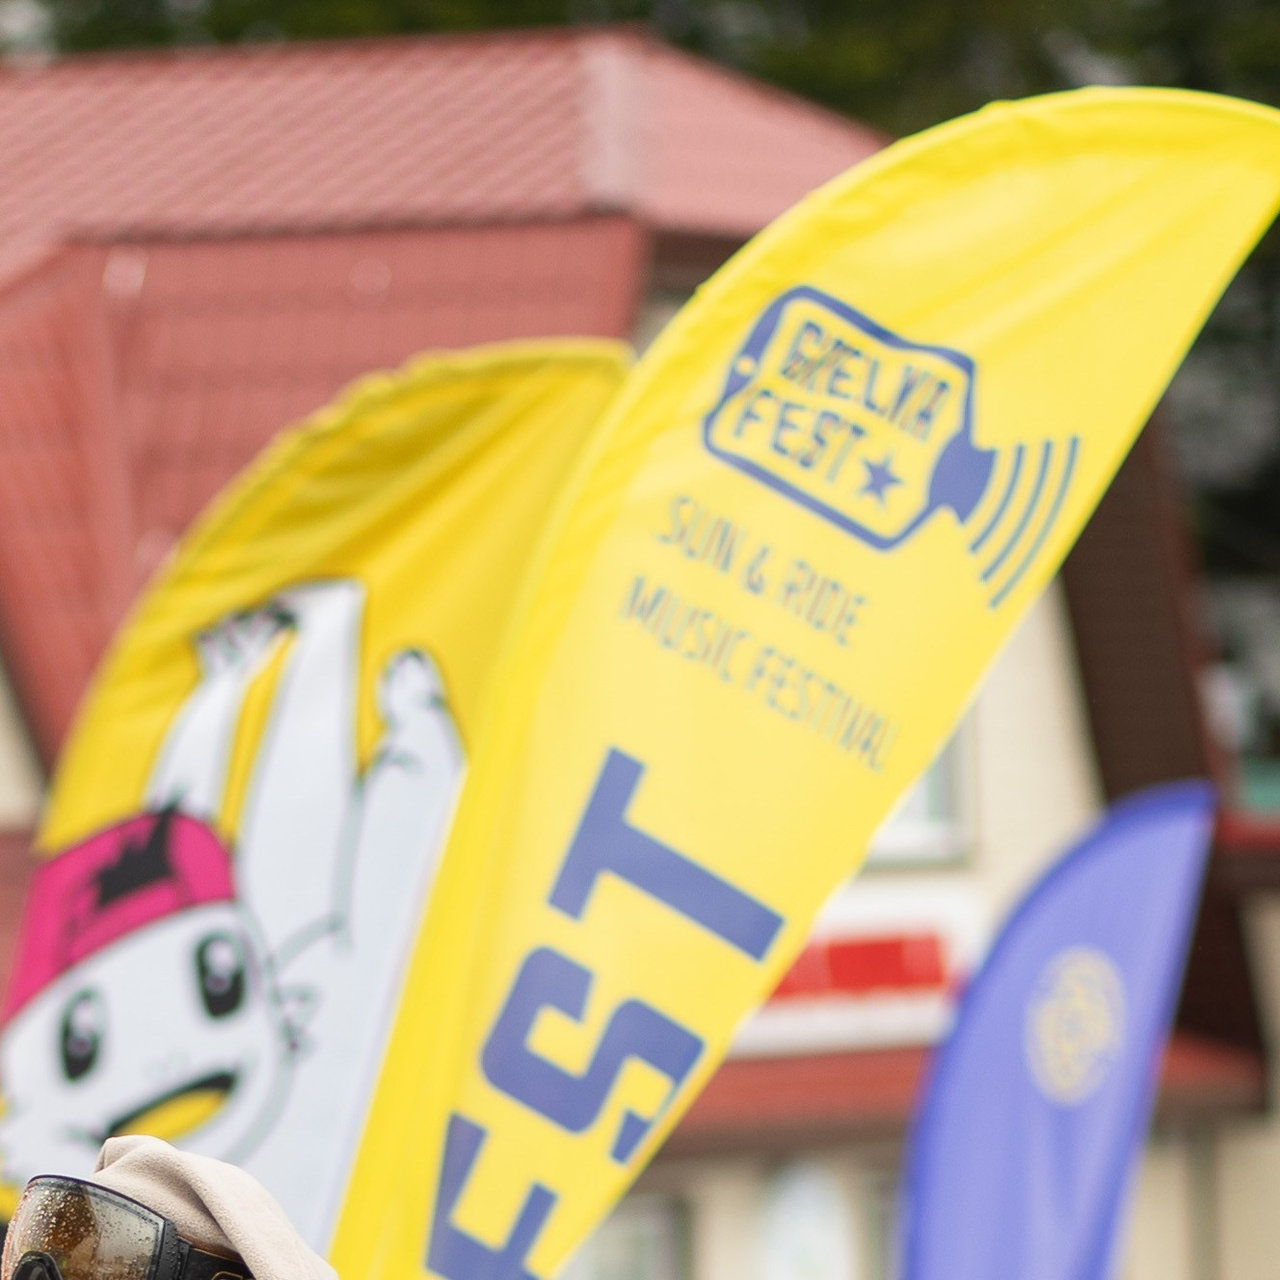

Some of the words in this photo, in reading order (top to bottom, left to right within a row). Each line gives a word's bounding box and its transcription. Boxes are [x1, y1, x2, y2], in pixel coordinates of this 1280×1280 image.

[732, 388, 866, 484] FEST
[778, 320, 950, 442] GRELKA
[655, 494, 749, 574] SUN
[778, 557, 869, 649] RIDE
[619, 575, 750, 683] MUSIC
[747, 645, 900, 775] FESTIVAL
